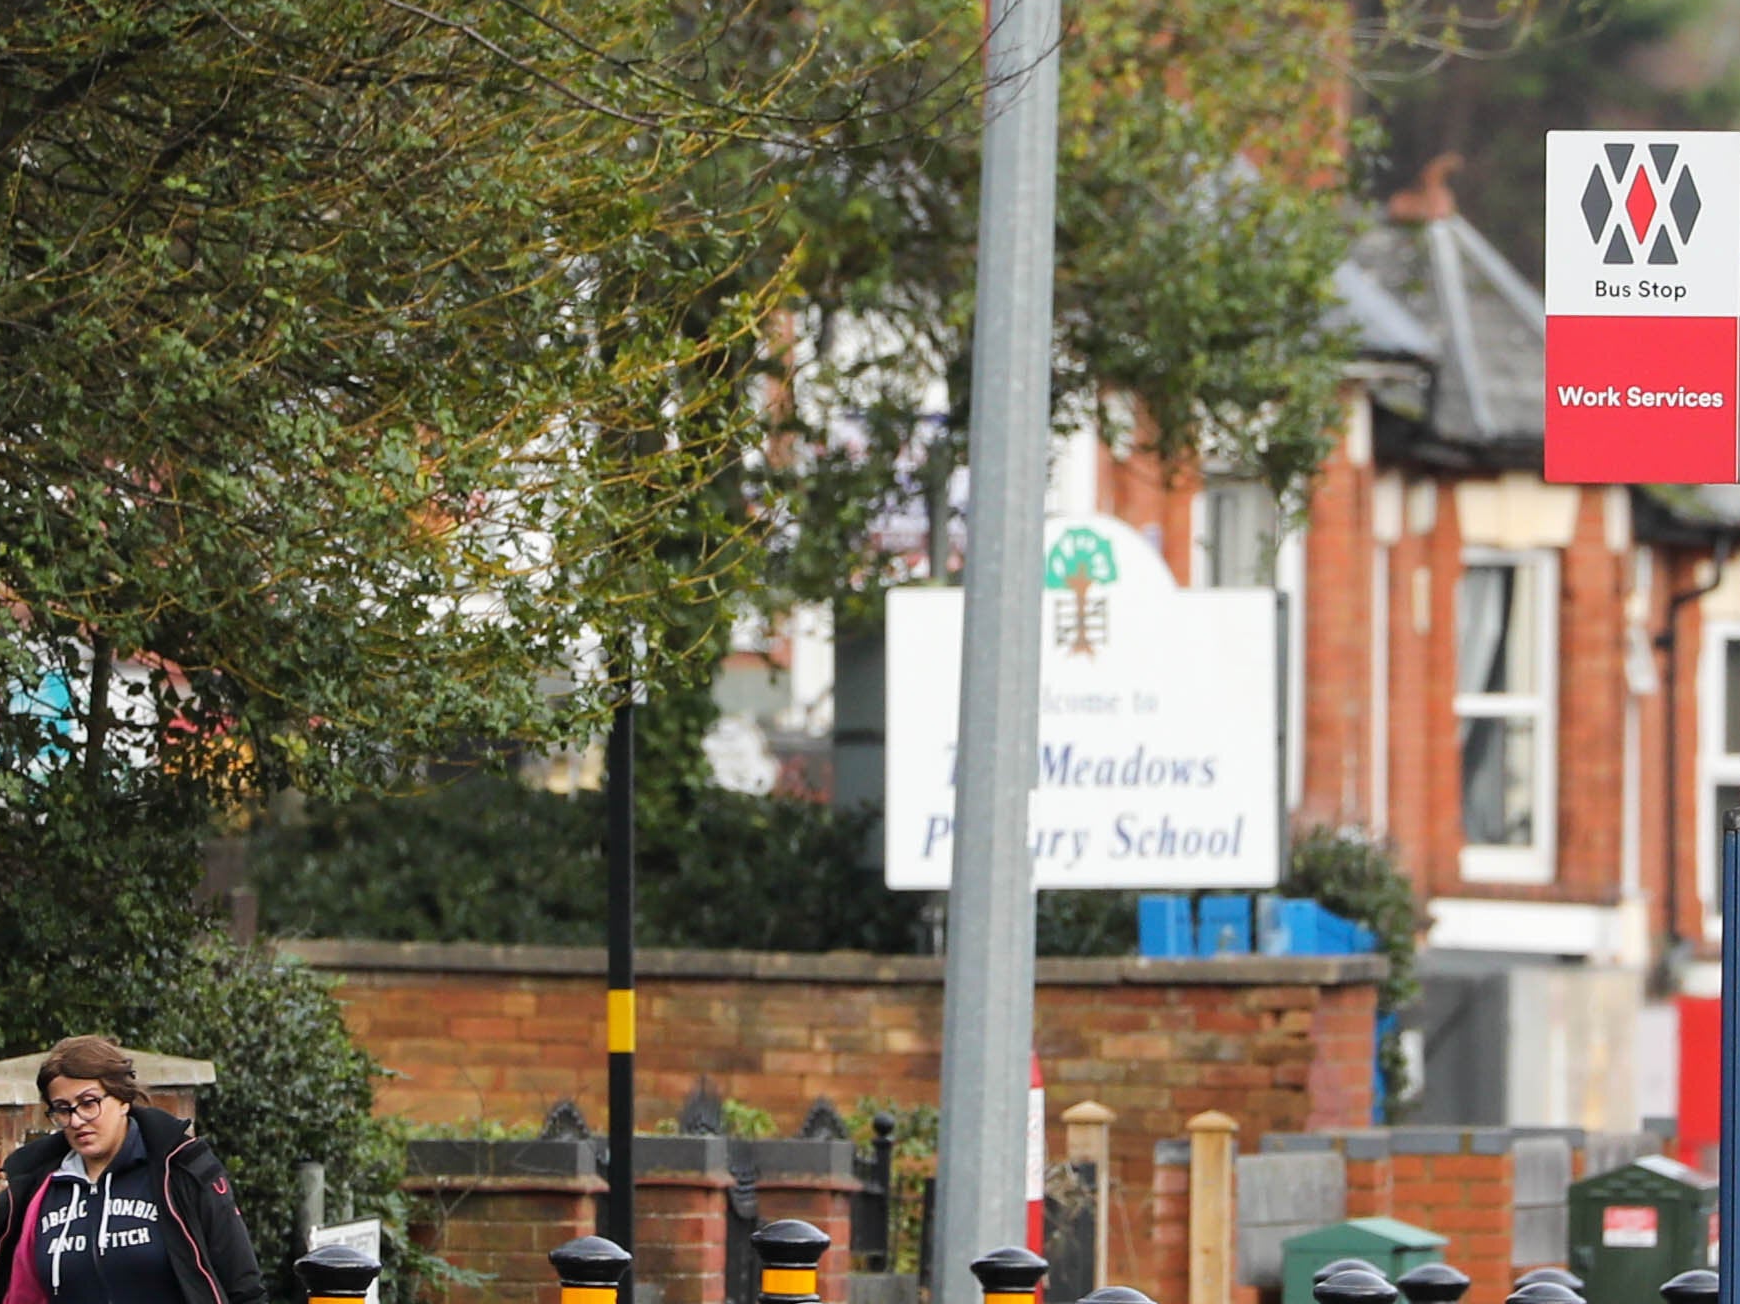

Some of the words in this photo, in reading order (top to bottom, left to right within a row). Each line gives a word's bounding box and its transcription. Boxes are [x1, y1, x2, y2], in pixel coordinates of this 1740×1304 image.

[1594, 280, 1632, 299] Bus
[1638, 280, 1687, 302] Stop
[1558, 386, 1621, 407] Work
[1626, 386, 1724, 408] Services
[1039, 744, 1218, 787] Meadows
[1108, 812, 1246, 860] School
[99, 1227, 151, 1249] FITCH
